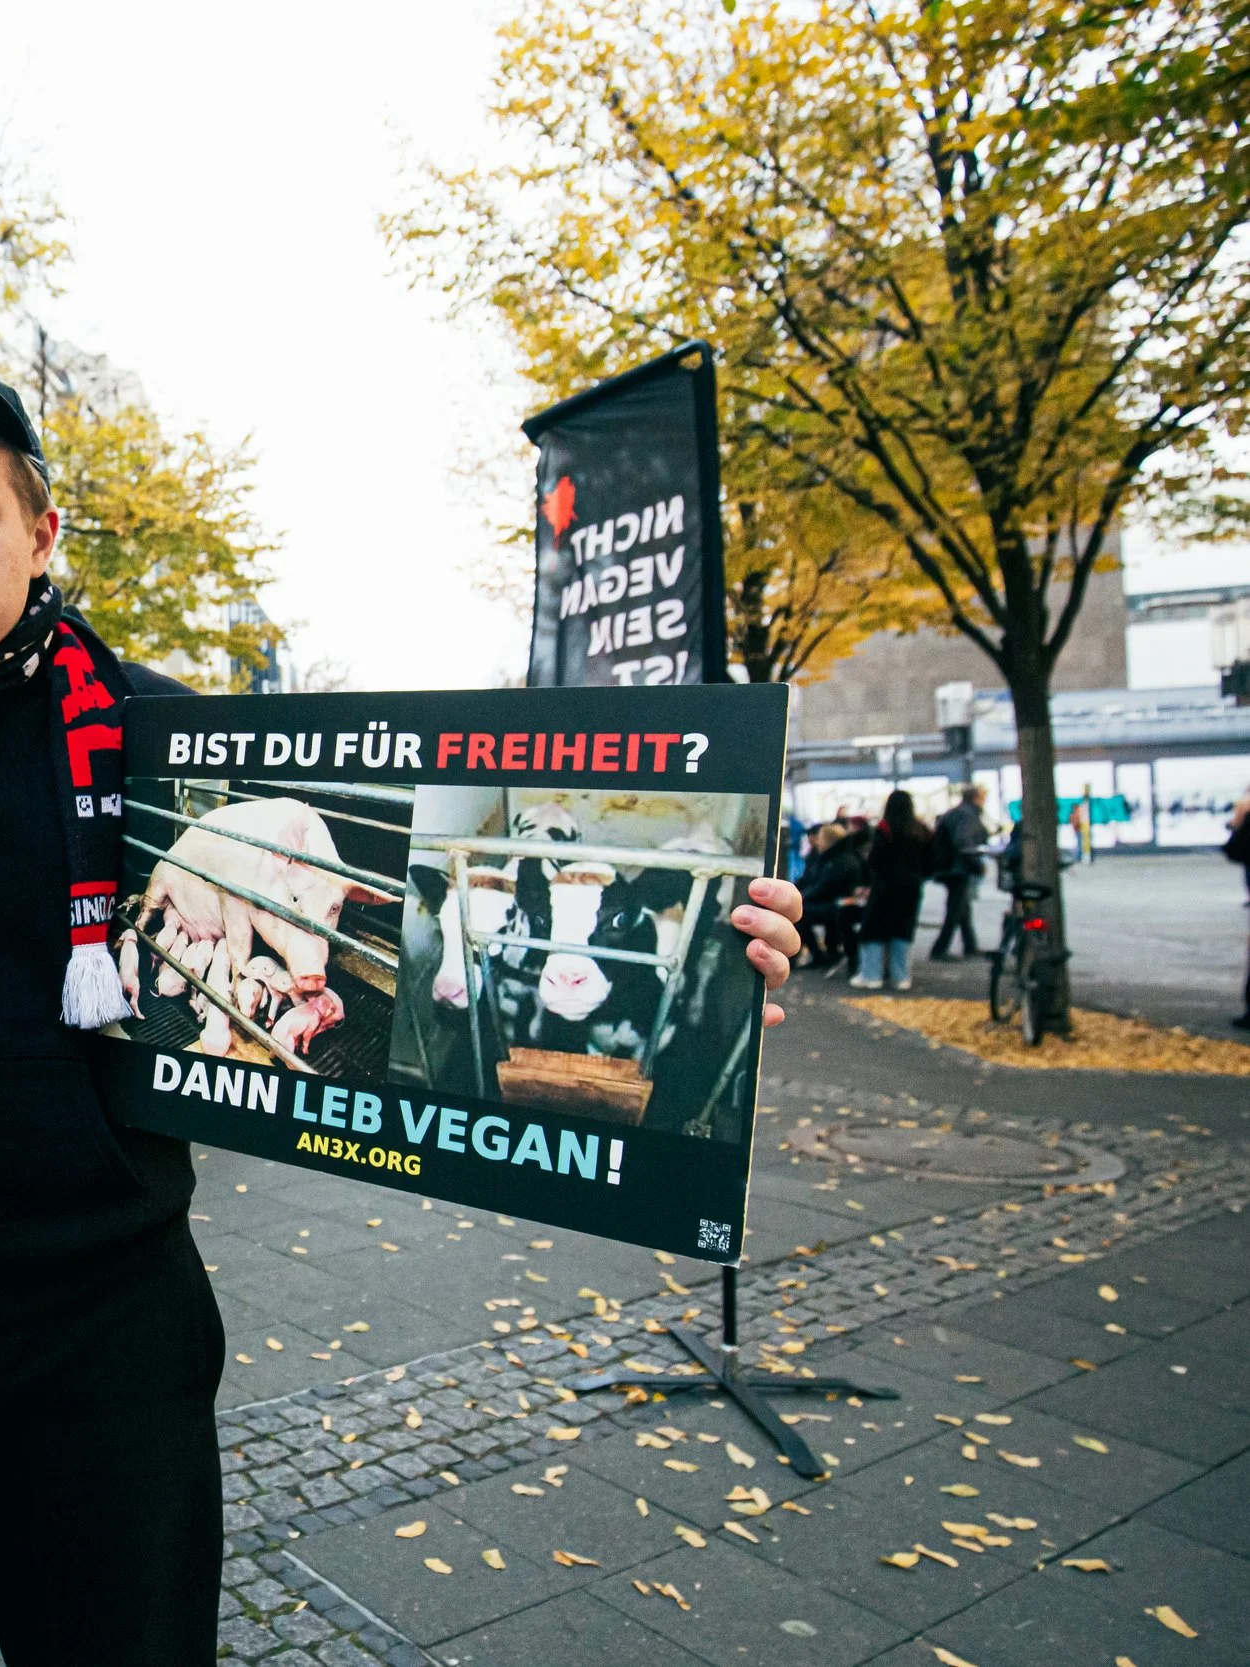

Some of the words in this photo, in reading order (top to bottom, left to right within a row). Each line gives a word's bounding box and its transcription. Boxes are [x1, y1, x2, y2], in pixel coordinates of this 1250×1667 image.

[168, 733, 255, 766] BIST
[263, 733, 322, 767] DU
[334, 721, 423, 768] FÜR
[436, 733, 709, 774] FREIHEIT?
[152, 1053, 280, 1114] DANN
[292, 1080, 383, 1134] LEB
[400, 1099, 624, 1185] VEGAN!
[296, 1131, 422, 1176] AN3X.ORG
